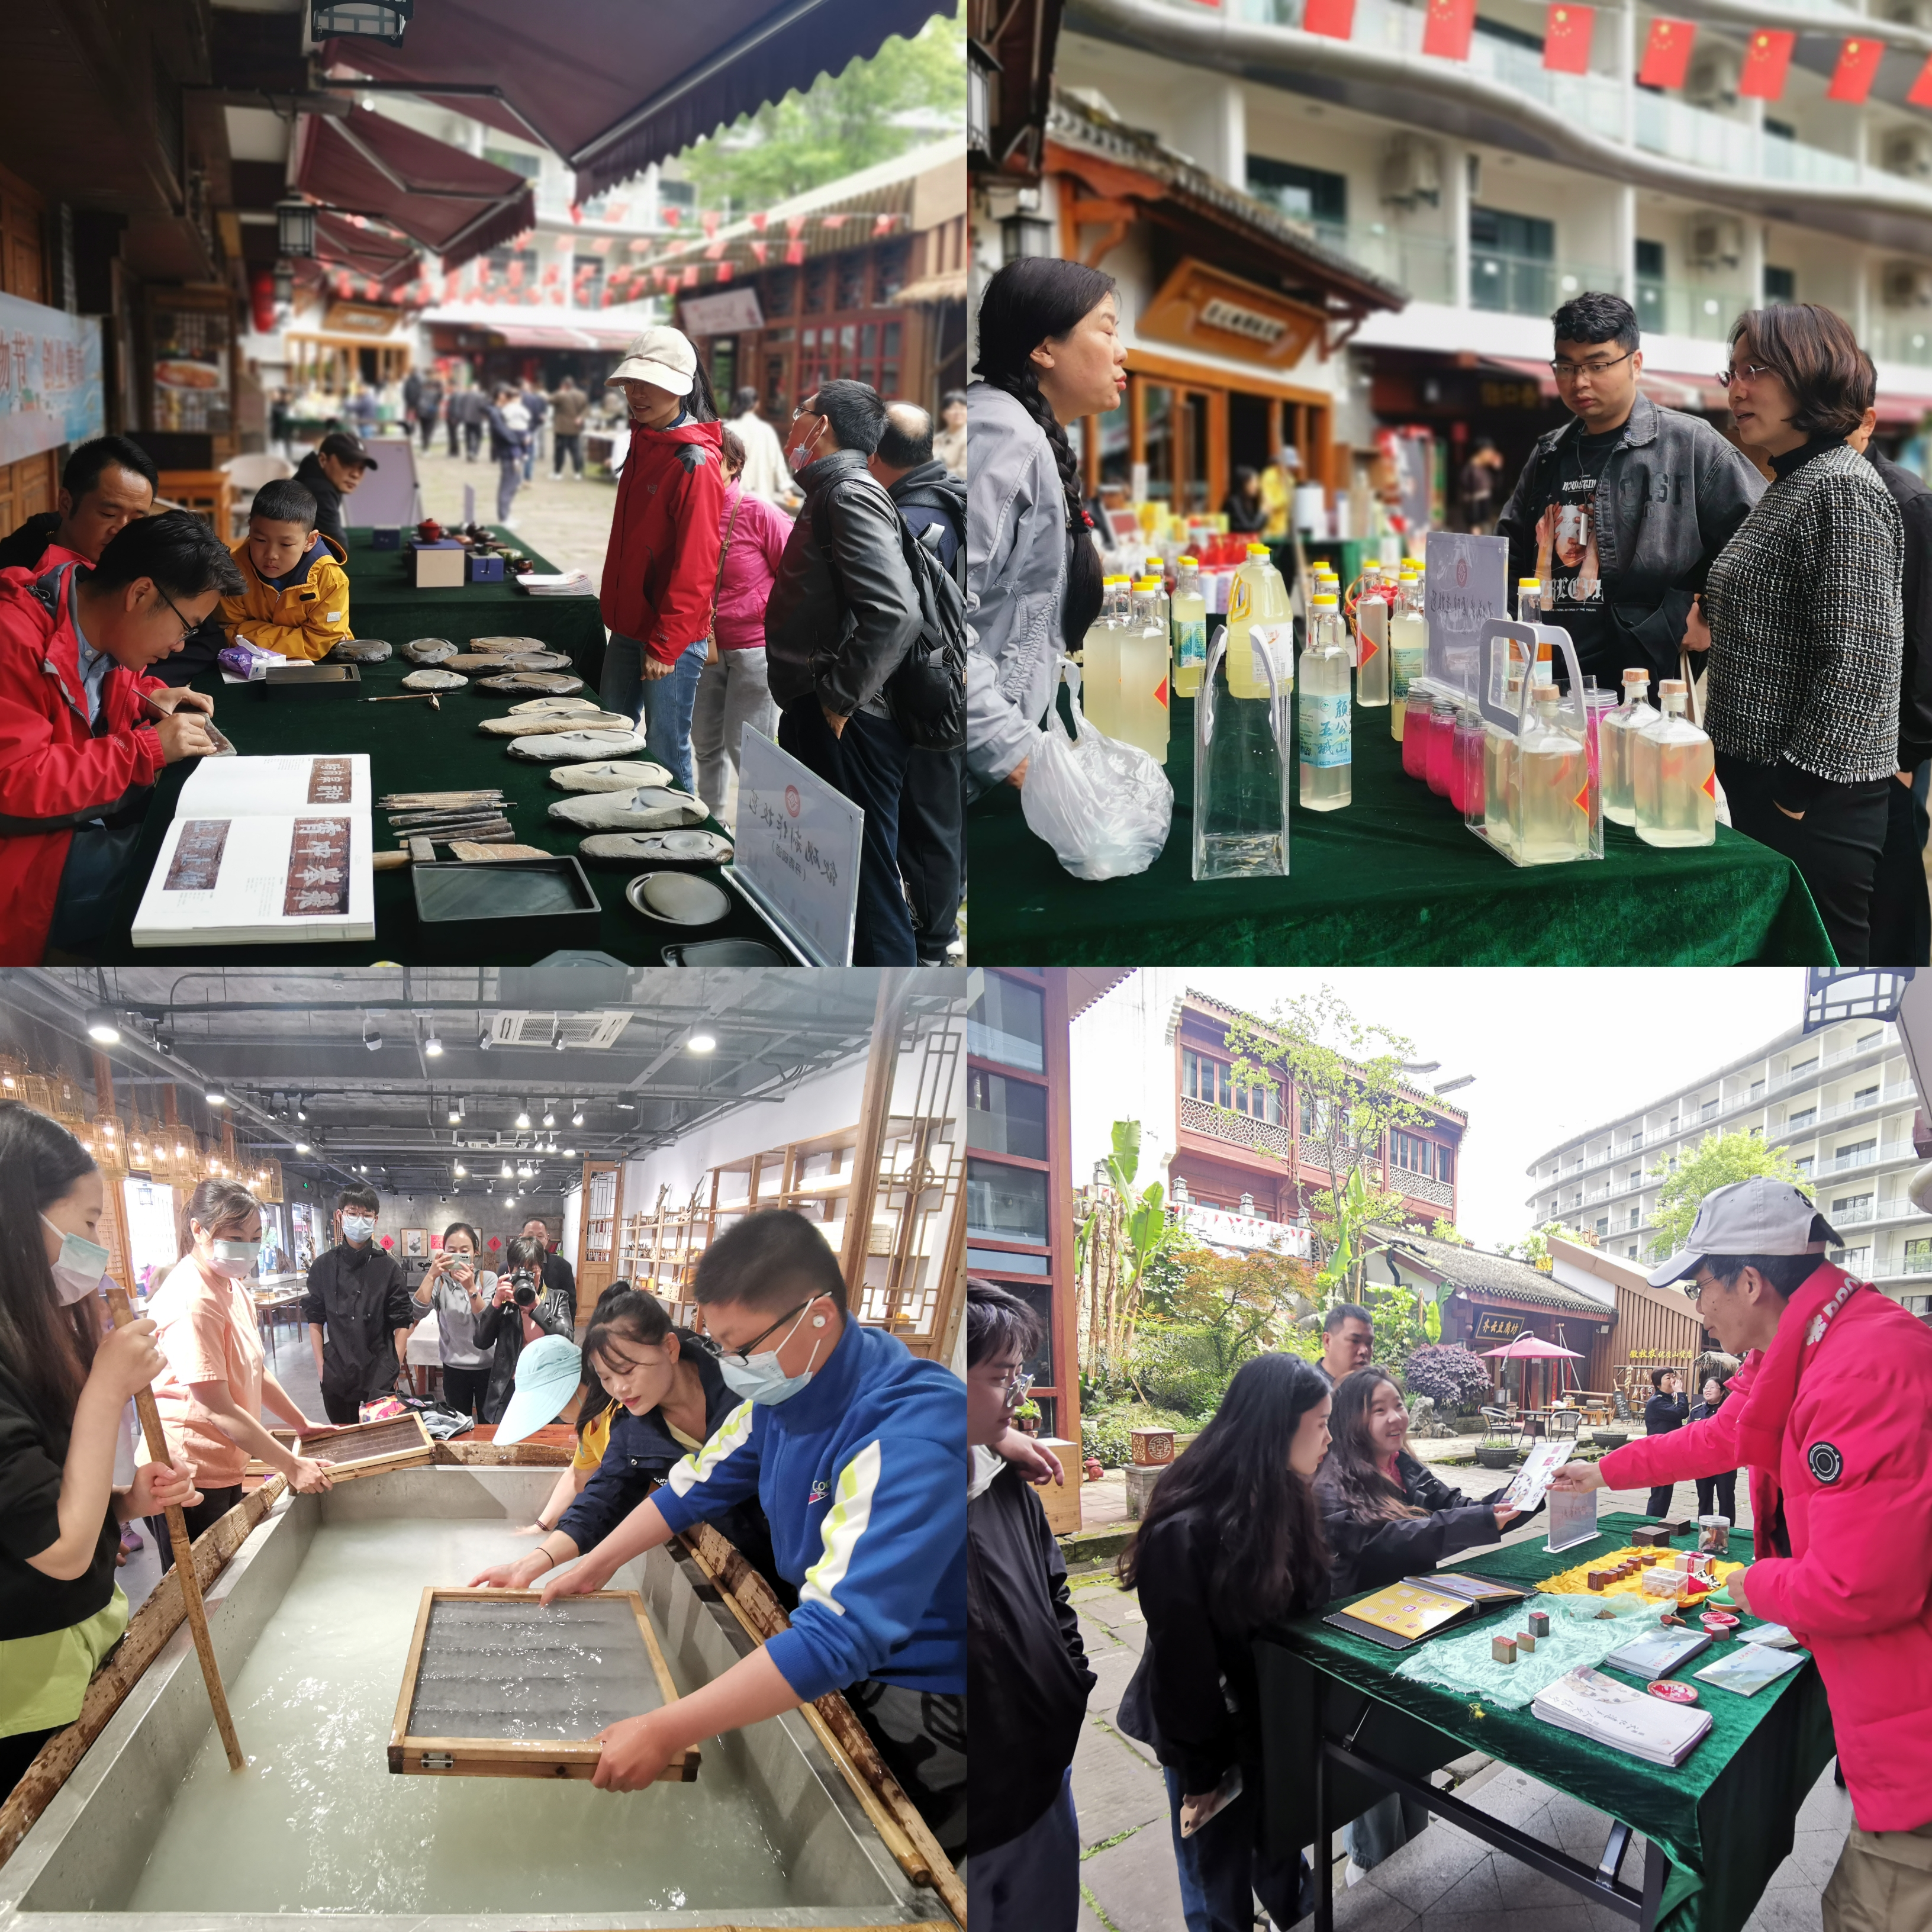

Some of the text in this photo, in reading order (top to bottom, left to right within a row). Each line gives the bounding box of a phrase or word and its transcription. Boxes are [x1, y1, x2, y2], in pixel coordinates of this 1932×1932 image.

[1483, 1318, 1519, 1335] 齐云豆腐坊
[1658, 1350, 1693, 1359] 优质山货店
